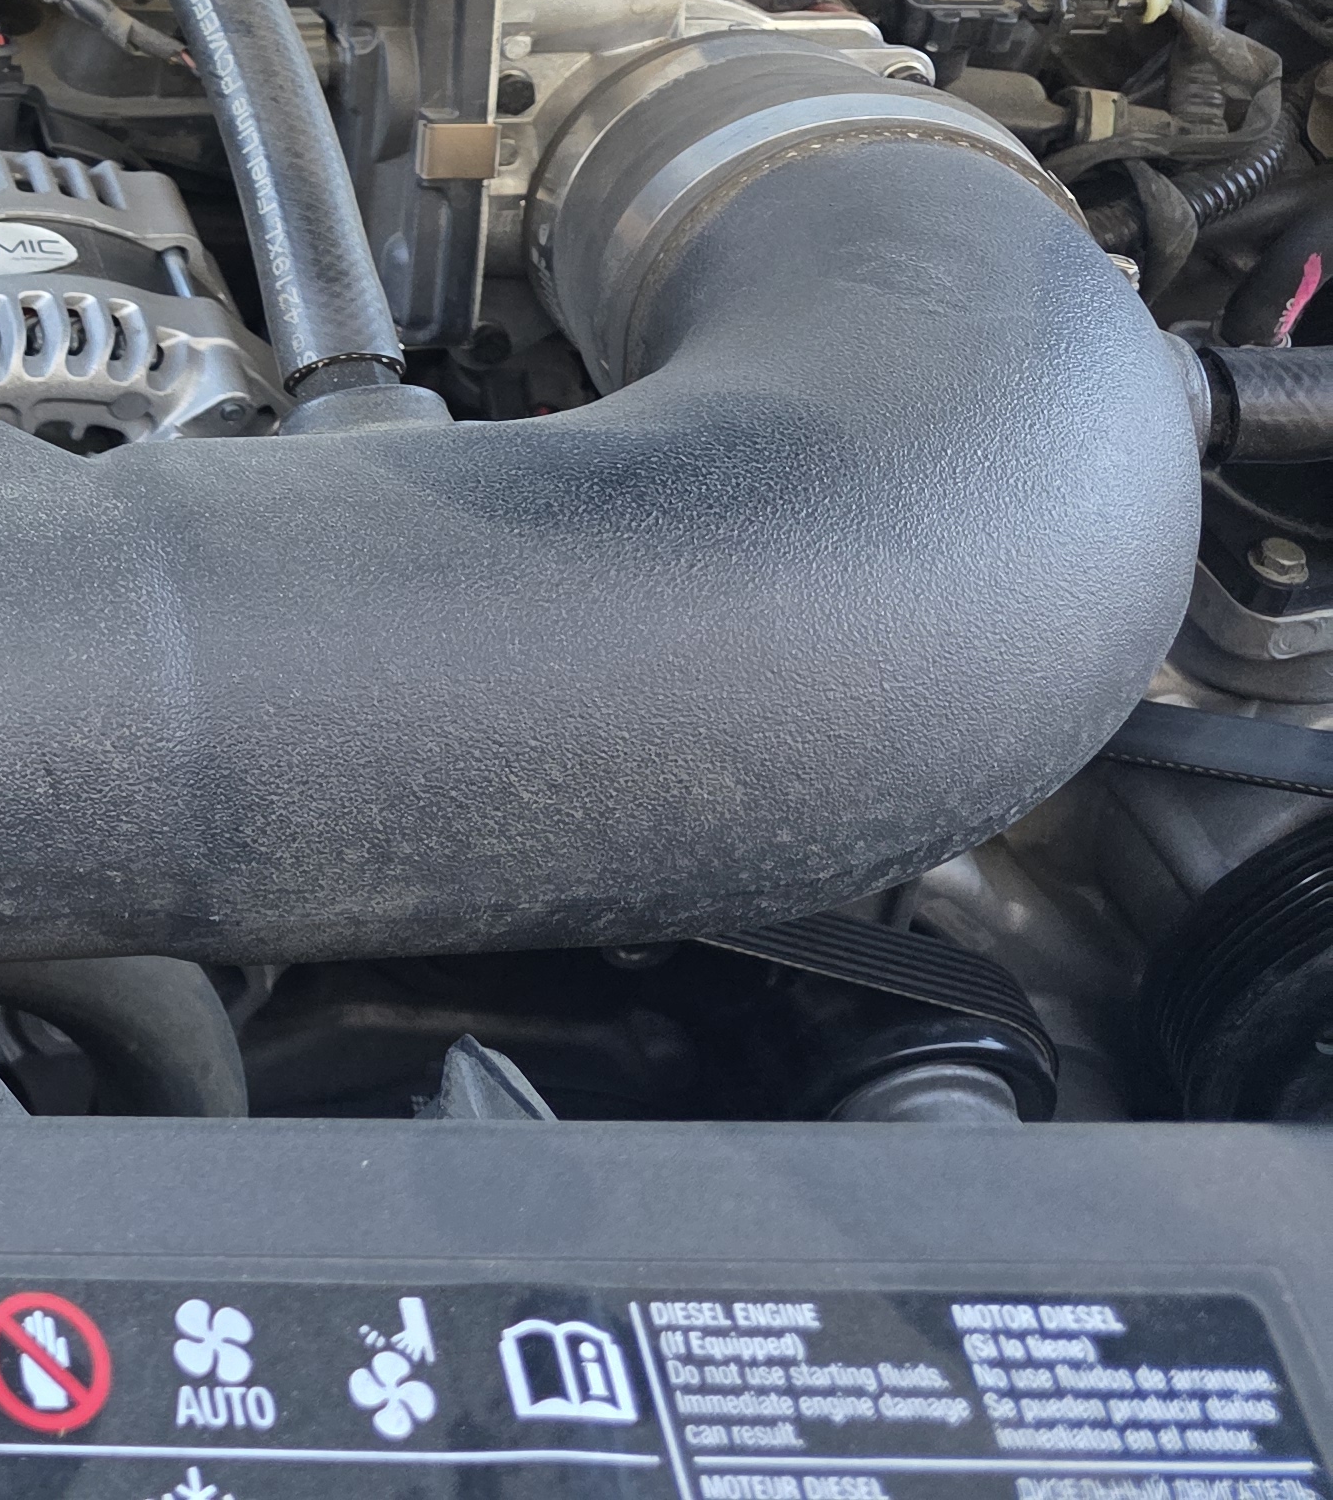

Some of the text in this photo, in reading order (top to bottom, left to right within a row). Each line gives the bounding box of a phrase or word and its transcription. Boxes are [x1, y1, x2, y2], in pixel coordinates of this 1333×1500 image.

[228, 96, 261, 155] Line
[248, 153, 279, 215] Fuel
[649, 1302, 821, 1329] DIESEL ENGINE
[951, 1304, 1127, 1332] MOTOR DIESEL
[660, 1331, 806, 1362] (If Equipped)
[666, 1361, 950, 1392] Do not use starting fluids.
[972, 1364, 1009, 1390] No
[1010, 1367, 1055, 1391] use
[1135, 1365, 1168, 1391] de
[175, 1385, 275, 1429] AUTO
[676, 1390, 973, 1426] Immediate engine damage
[983, 1393, 1018, 1420] Se
[1020, 1395, 1106, 1422] pueden
[685, 1422, 805, 1448] can result.
[1123, 1429, 1157, 1452] en
[699, 1475, 890, 1500] MOTEUR DIESEL
